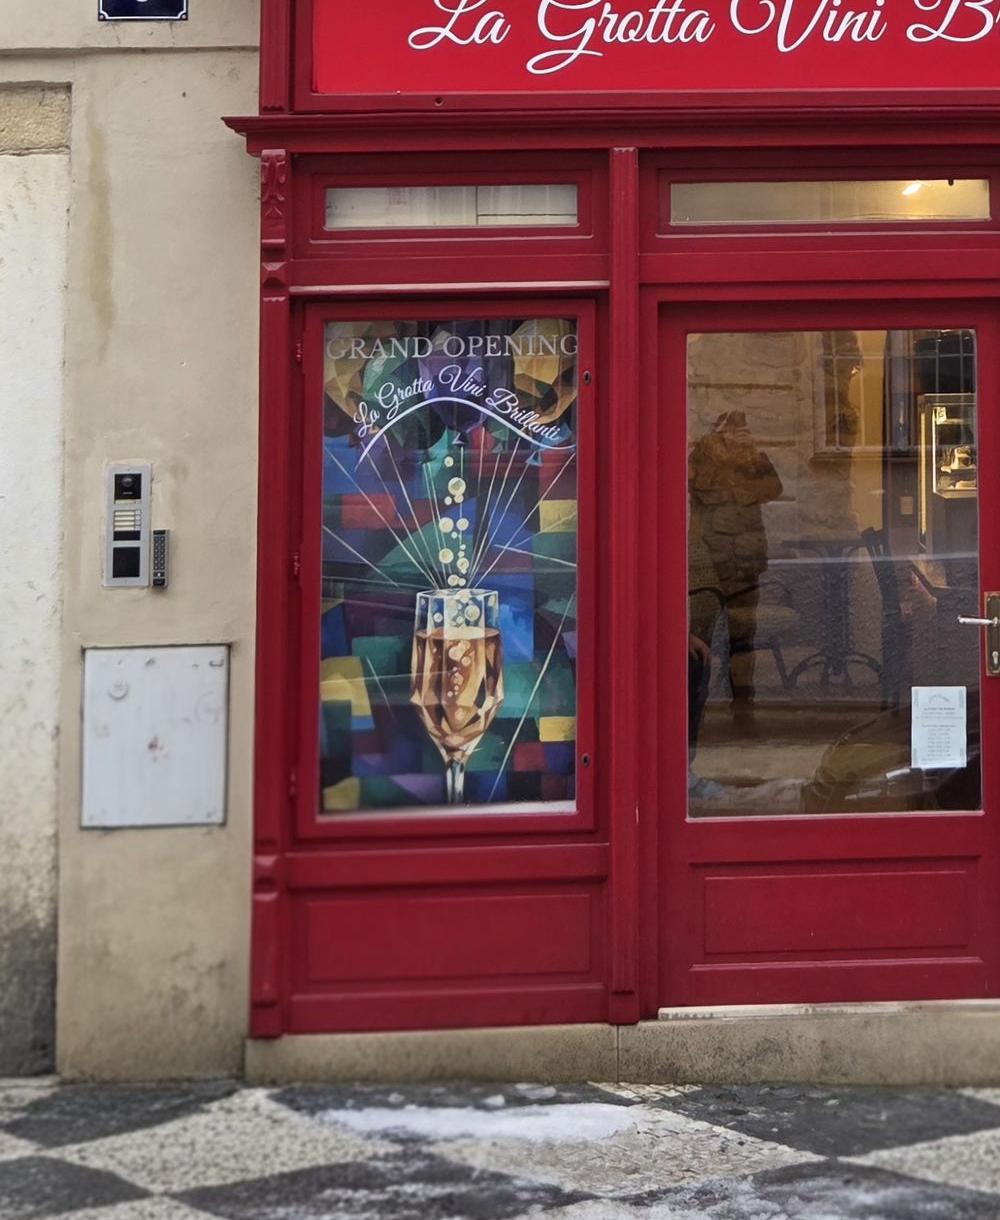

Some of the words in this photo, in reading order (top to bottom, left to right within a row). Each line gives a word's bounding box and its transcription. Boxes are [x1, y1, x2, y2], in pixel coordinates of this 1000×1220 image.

[326, 336, 433, 360] GRAND
[443, 334, 577, 358] OPENING
[353, 401, 381, 438] La
[374, 375, 436, 420] Grotta
[438, 363, 488, 398] Vini
[485, 386, 562, 441] Brillanti
